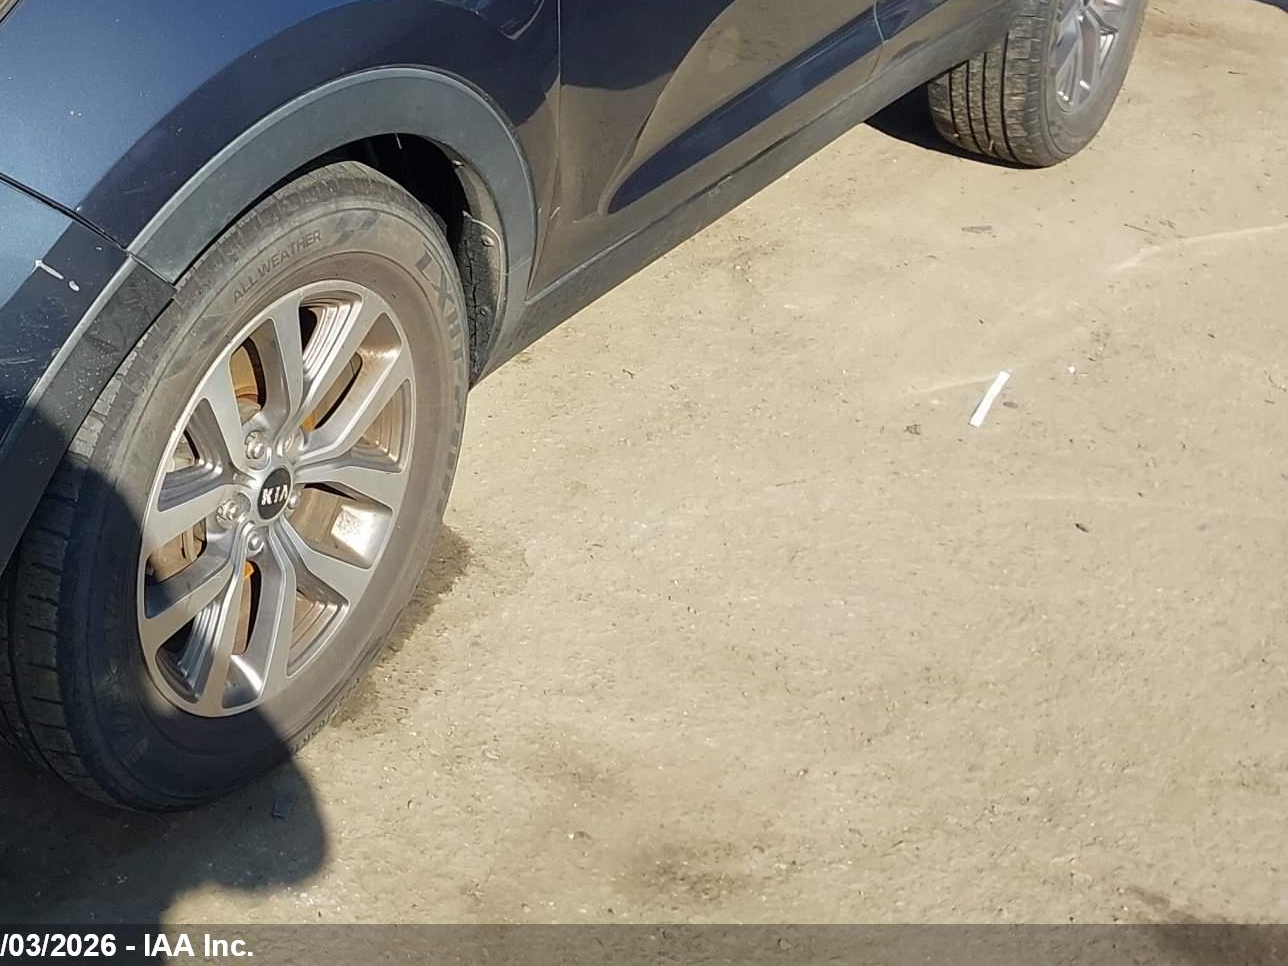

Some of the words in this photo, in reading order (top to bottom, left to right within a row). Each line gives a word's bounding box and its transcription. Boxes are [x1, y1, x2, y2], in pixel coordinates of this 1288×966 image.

[233, 275, 258, 303] ALL
[257, 230, 321, 277] WEATHER
[261, 484, 288, 505] KIA
